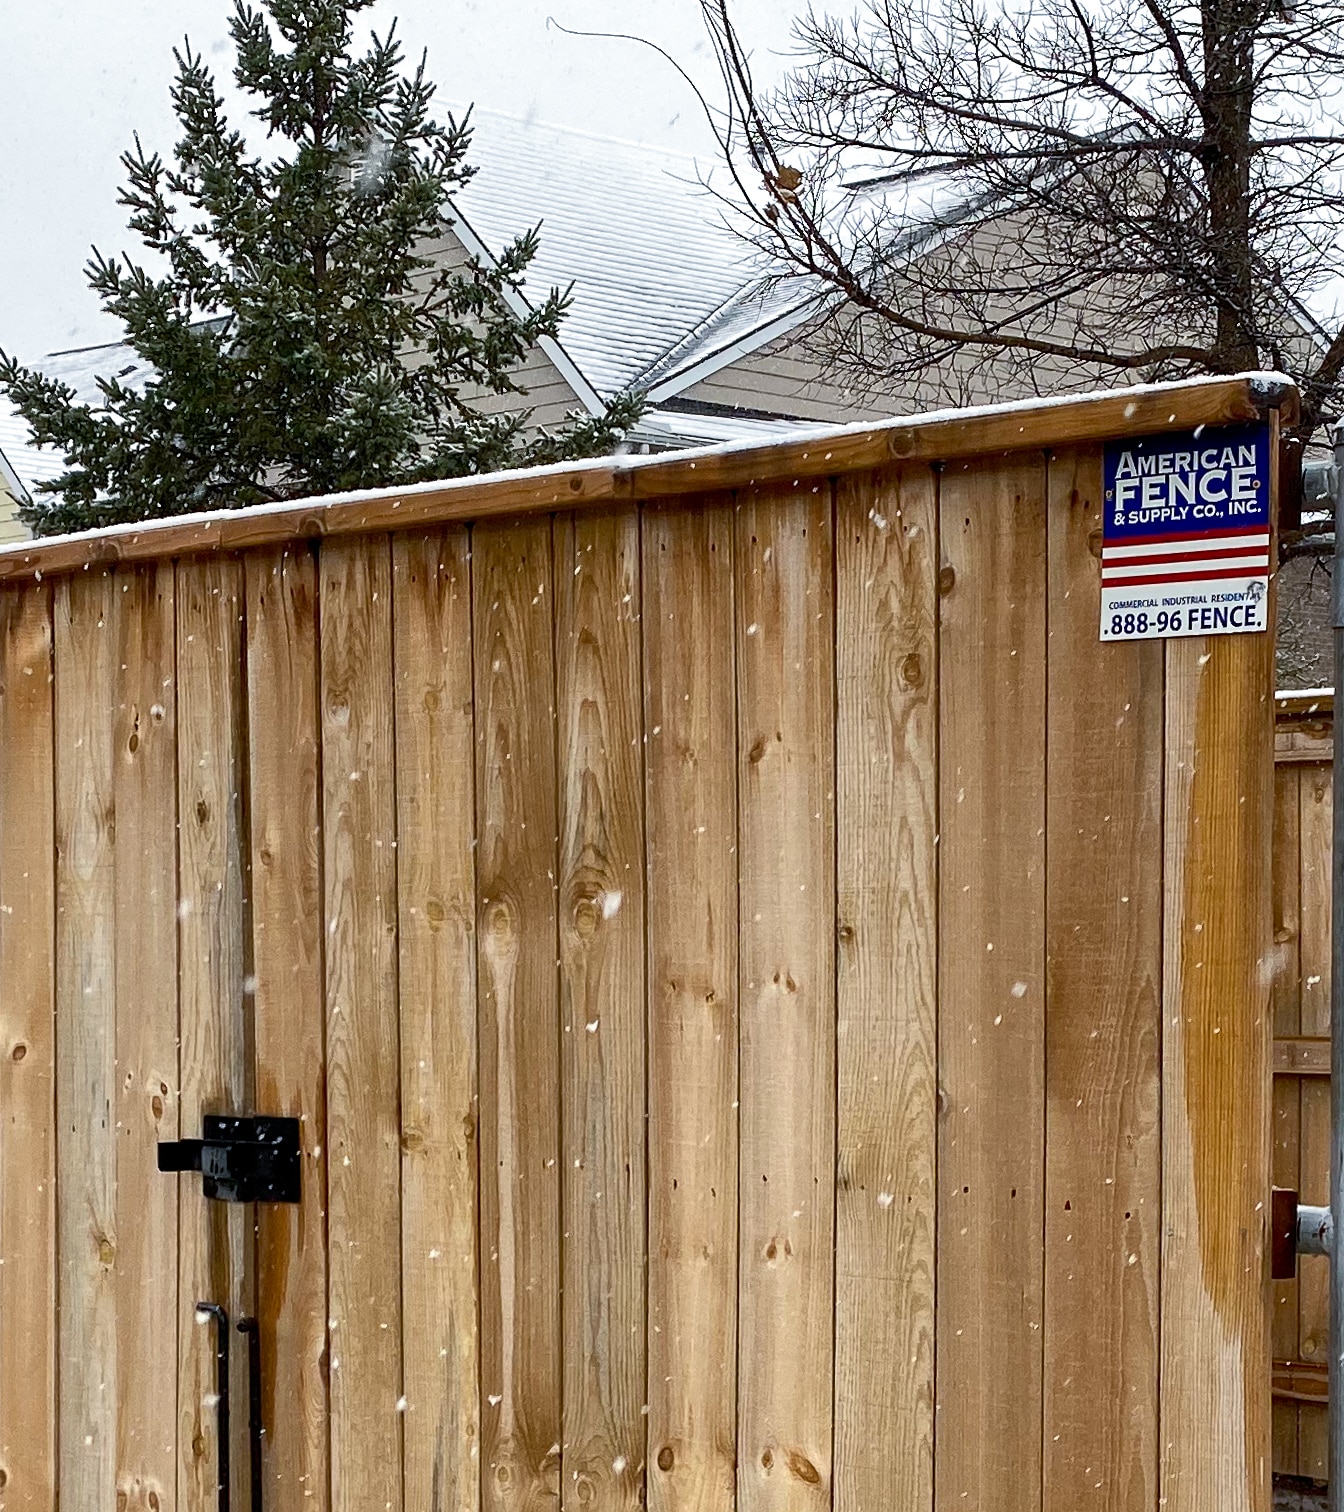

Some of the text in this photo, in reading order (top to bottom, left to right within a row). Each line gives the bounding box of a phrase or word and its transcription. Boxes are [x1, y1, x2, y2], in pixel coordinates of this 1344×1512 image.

[1114, 444, 1257, 480] AMERICAN
[1114, 465, 1257, 512] FENCE
[1113, 500, 1262, 526] & SUPPLY CO., INC.
[1108, 591, 1262, 610] COMMERCIAL INDUSTRIAL RESIDENT
